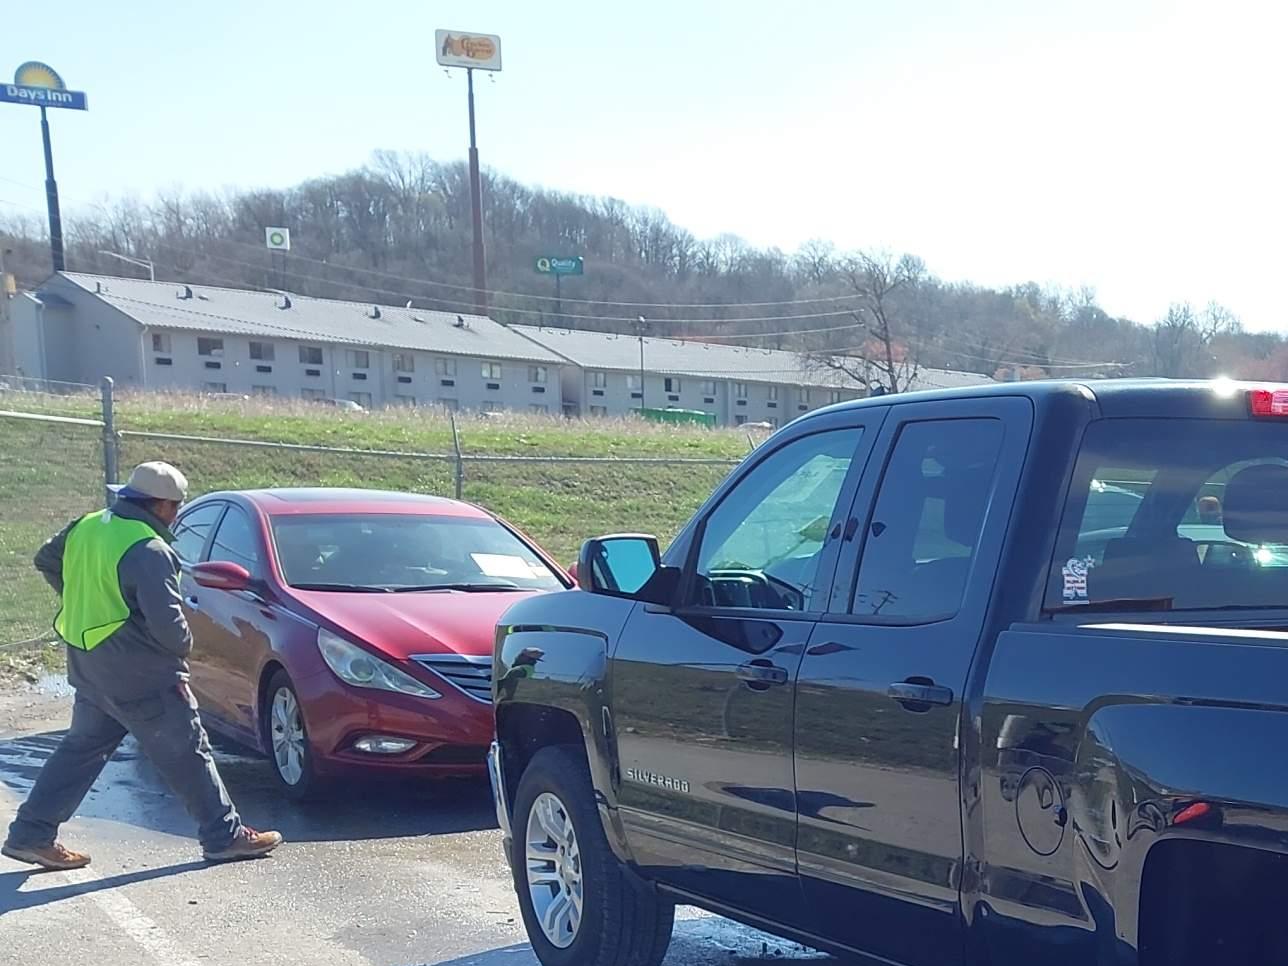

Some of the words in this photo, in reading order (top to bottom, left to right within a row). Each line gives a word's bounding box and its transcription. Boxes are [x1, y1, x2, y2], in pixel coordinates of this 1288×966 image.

[6, 85, 46, 100] Days
[47, 88, 73, 103] Inn
[626, 767, 690, 793] SILVERADO
